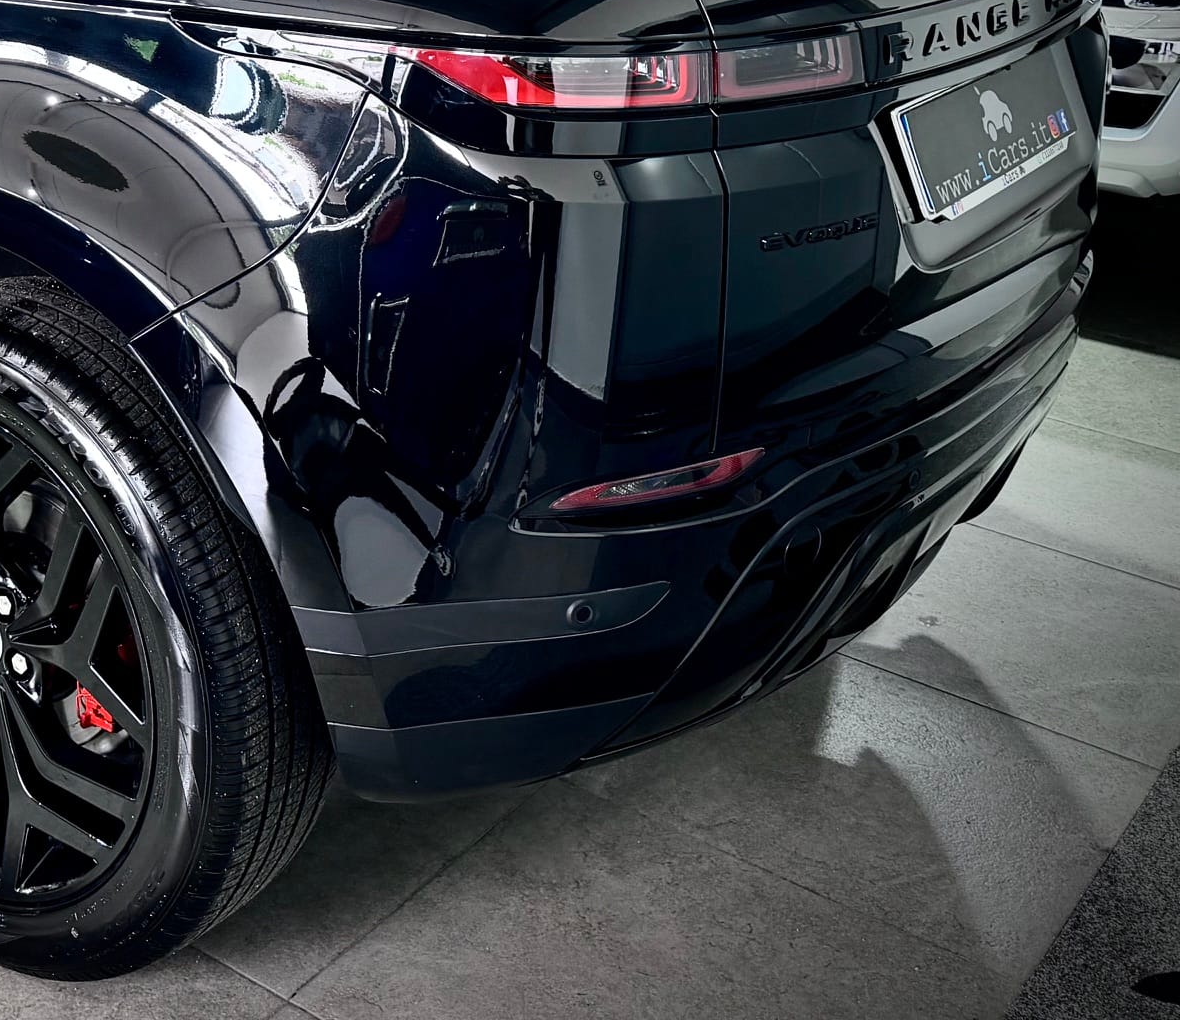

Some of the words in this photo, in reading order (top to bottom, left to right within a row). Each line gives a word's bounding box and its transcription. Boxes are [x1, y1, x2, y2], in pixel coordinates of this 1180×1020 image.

[935, 121, 1052, 205] www.iCars.it
[759, 211, 878, 253] EVOQUE
[17, 395, 111, 488] ZERO
